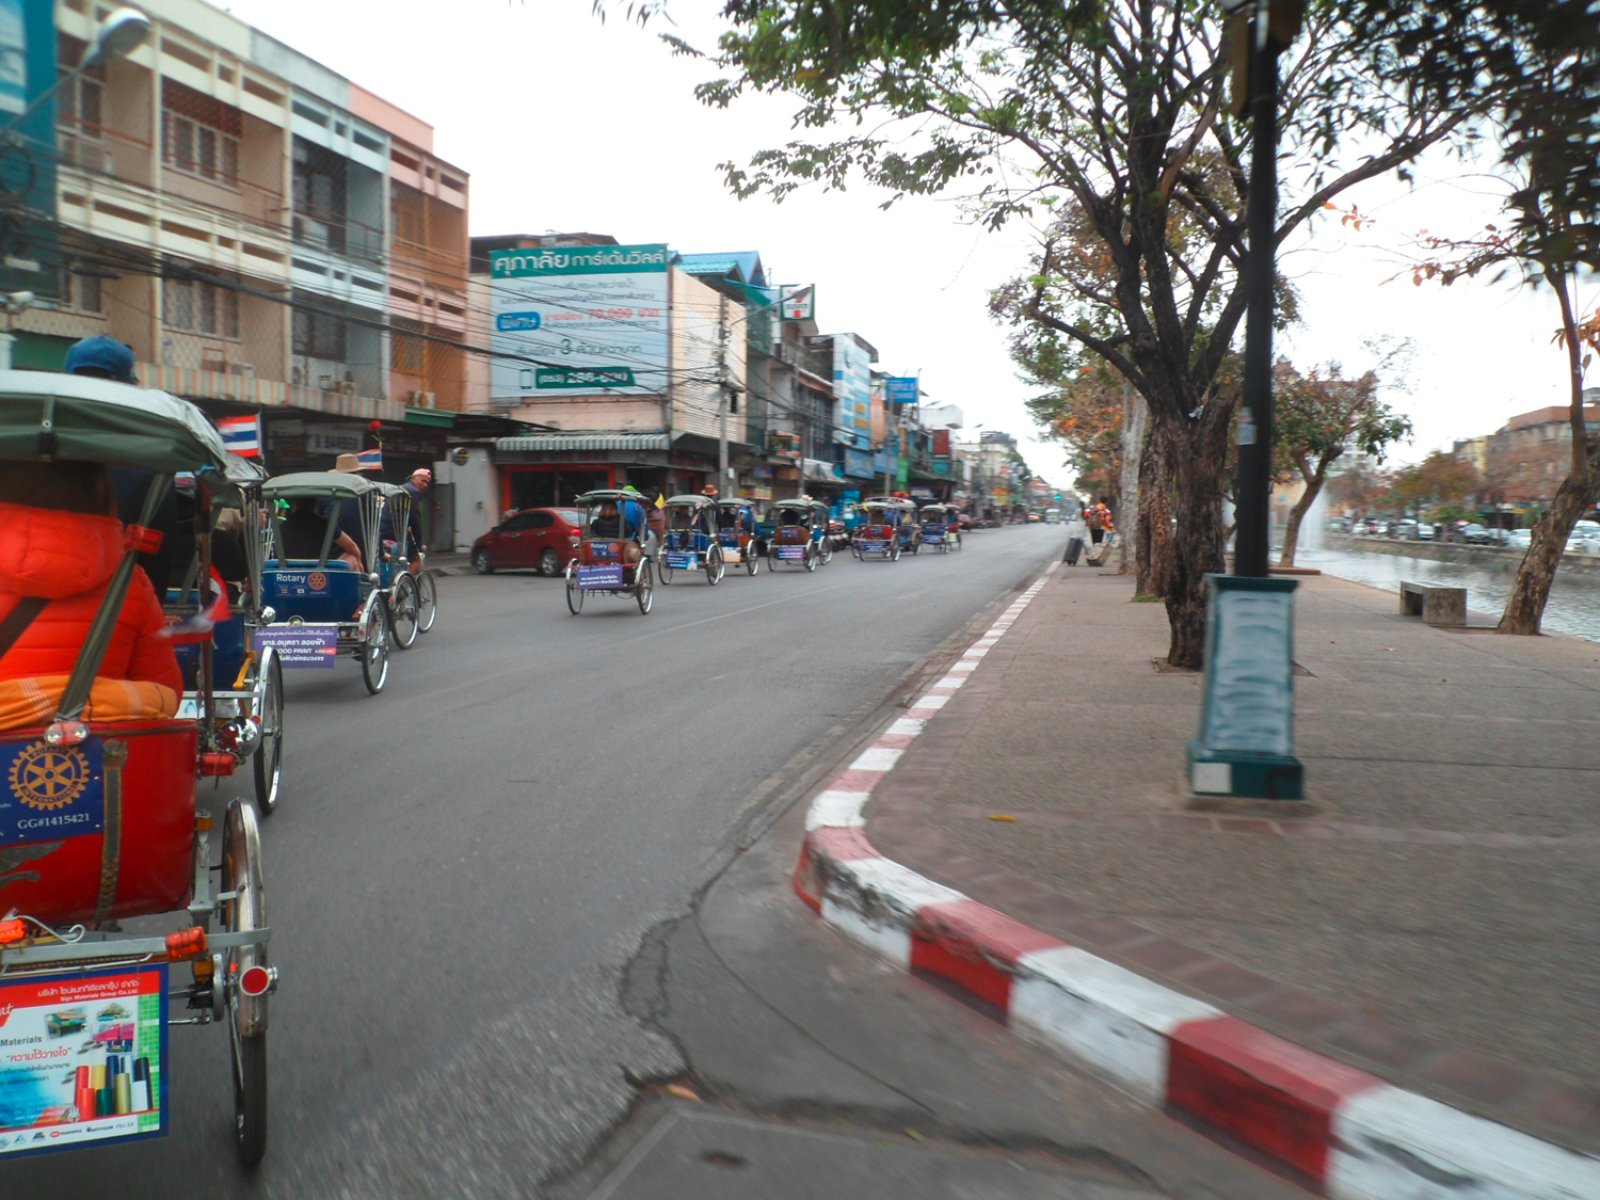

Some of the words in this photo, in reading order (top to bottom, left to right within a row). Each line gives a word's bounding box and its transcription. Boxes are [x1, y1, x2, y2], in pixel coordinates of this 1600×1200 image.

[495, 251, 570, 276] ศุภาลัย
[572, 249, 665, 267] การ์เด้นวิลล์
[560, 338, 571, 355] 3
[276, 573, 306, 584] Rotary
[17, 813, 90, 830] GG#1415421
[0, 1035, 43, 1047] Materials
